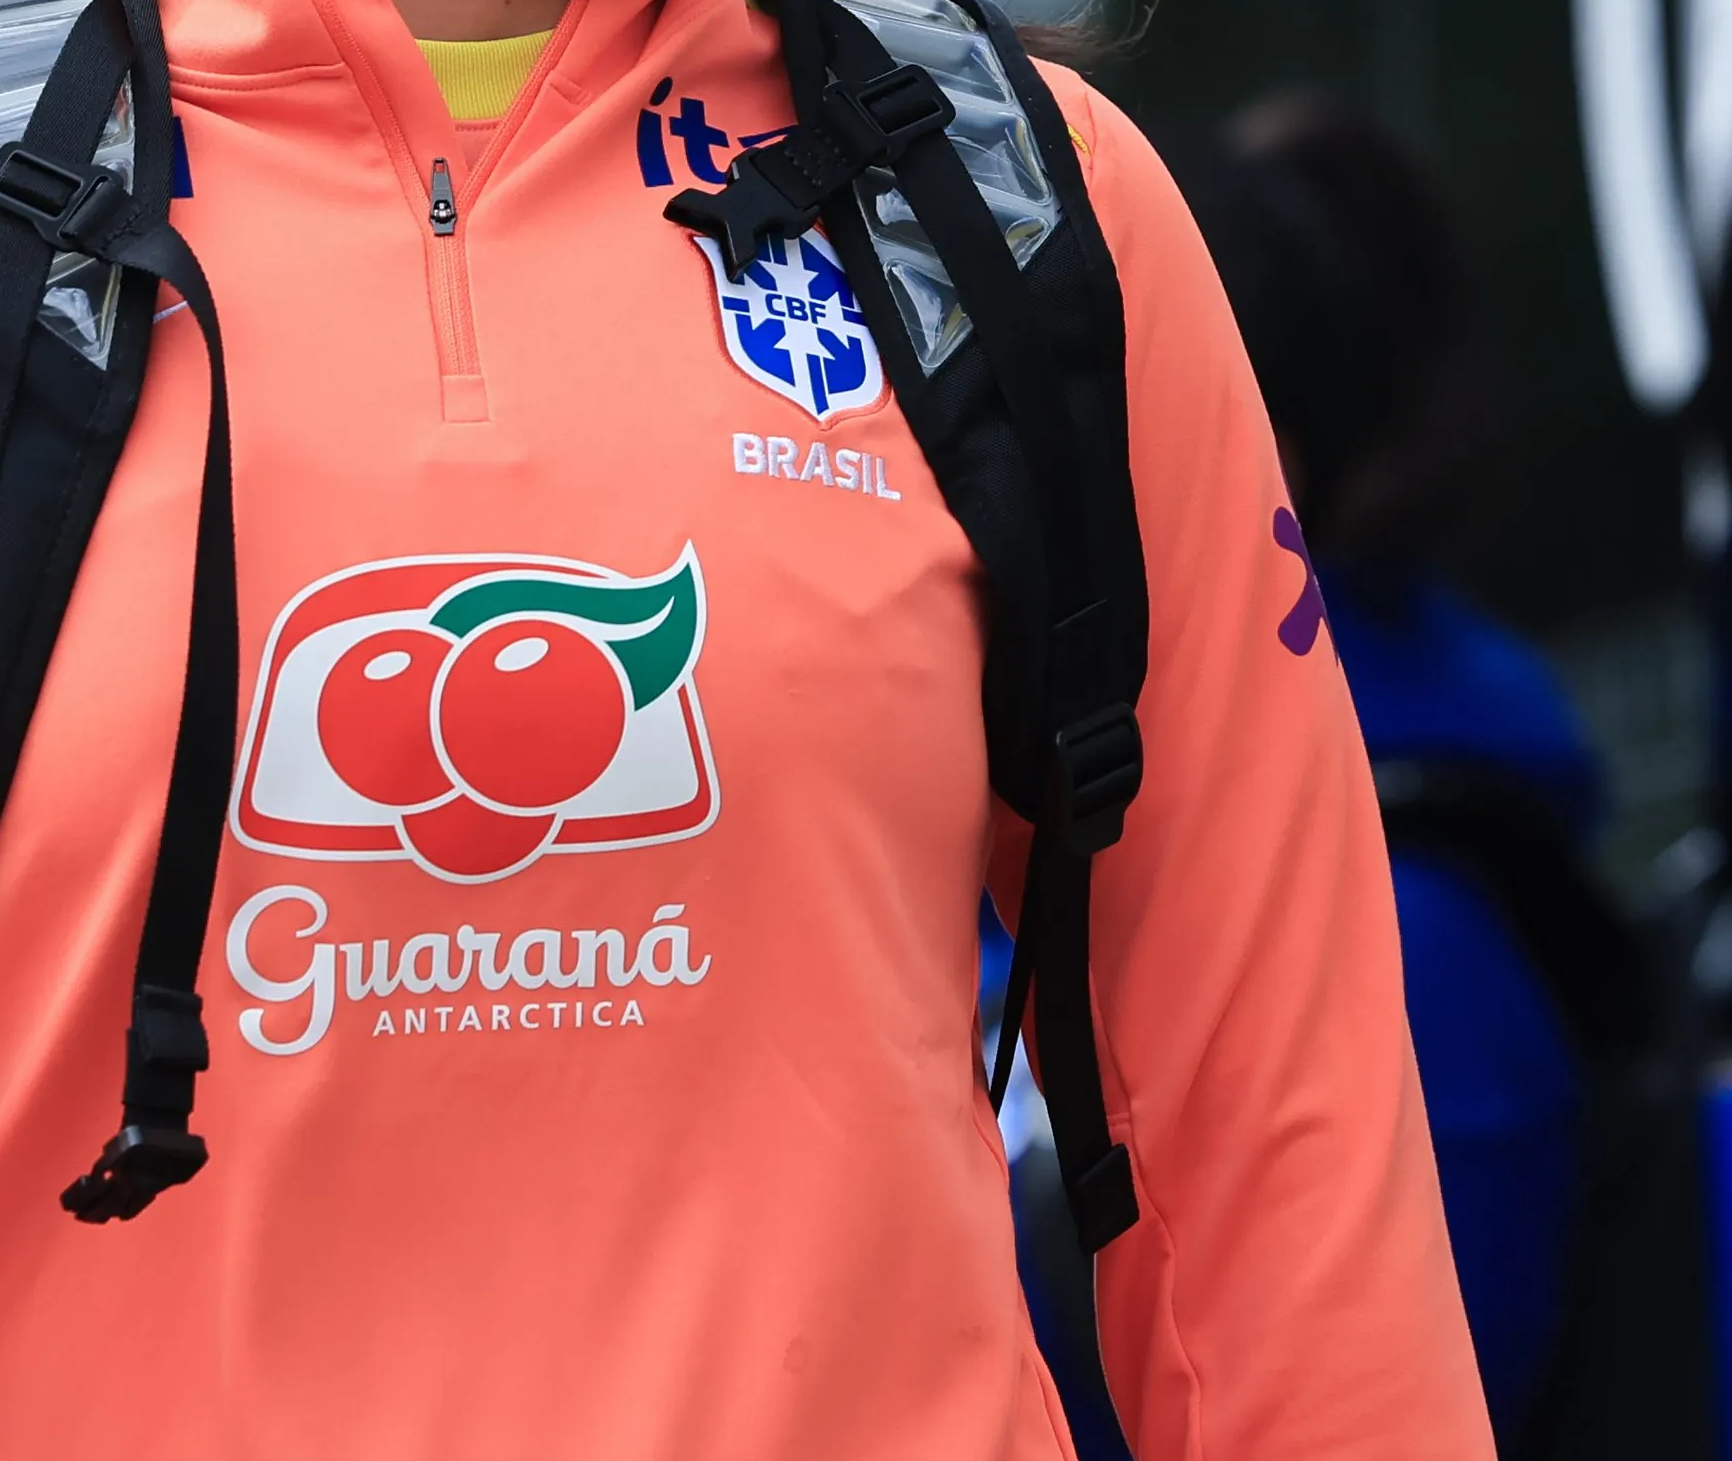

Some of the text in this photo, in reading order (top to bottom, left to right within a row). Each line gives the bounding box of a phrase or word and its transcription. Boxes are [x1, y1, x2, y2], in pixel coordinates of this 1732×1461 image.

[636, 76, 799, 188] it
[765, 293, 827, 325] CBF
[732, 433, 902, 500] BRASIL
[225, 884, 711, 1056] Guaraná
[372, 999, 645, 1037] ANTARCTICA
